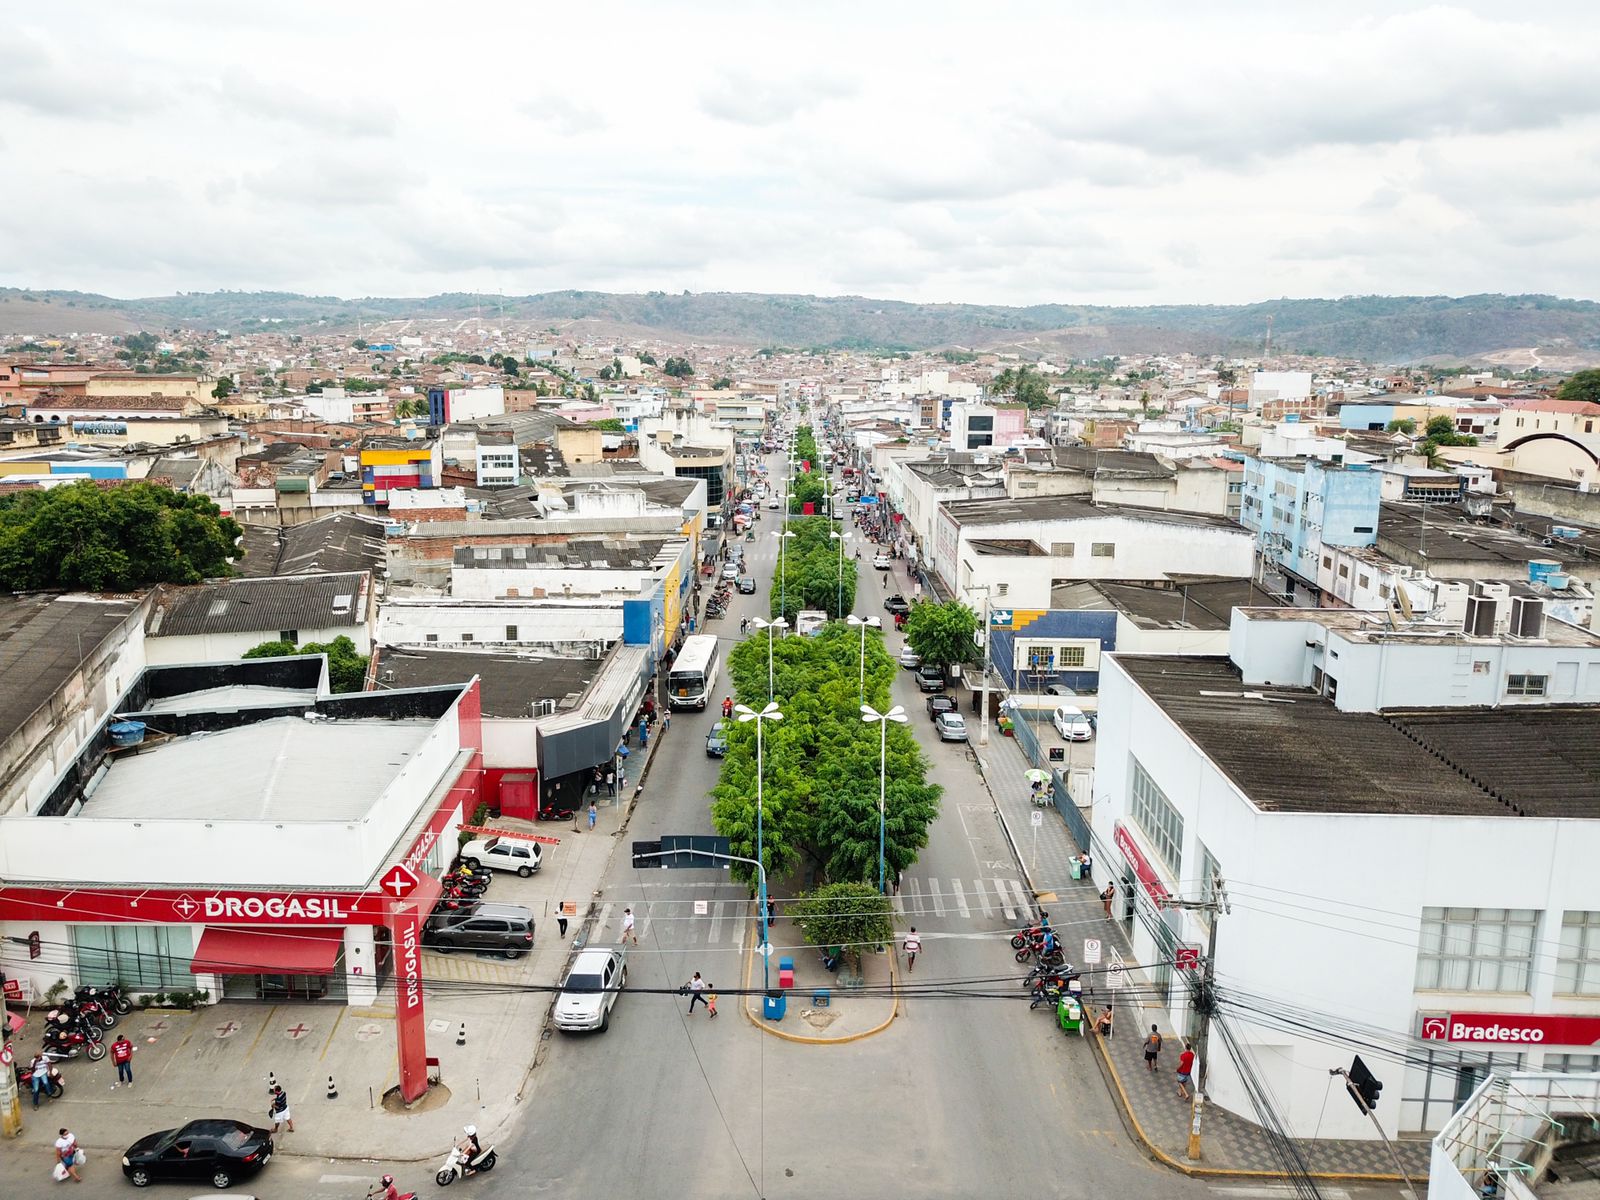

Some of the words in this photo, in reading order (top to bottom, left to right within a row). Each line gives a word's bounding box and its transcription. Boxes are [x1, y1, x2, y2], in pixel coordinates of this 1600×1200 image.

[204, 897, 348, 919] DROGASIL
[404, 921, 419, 1008] DROGASIL
[1452, 1023, 1544, 1042] Bradesco
